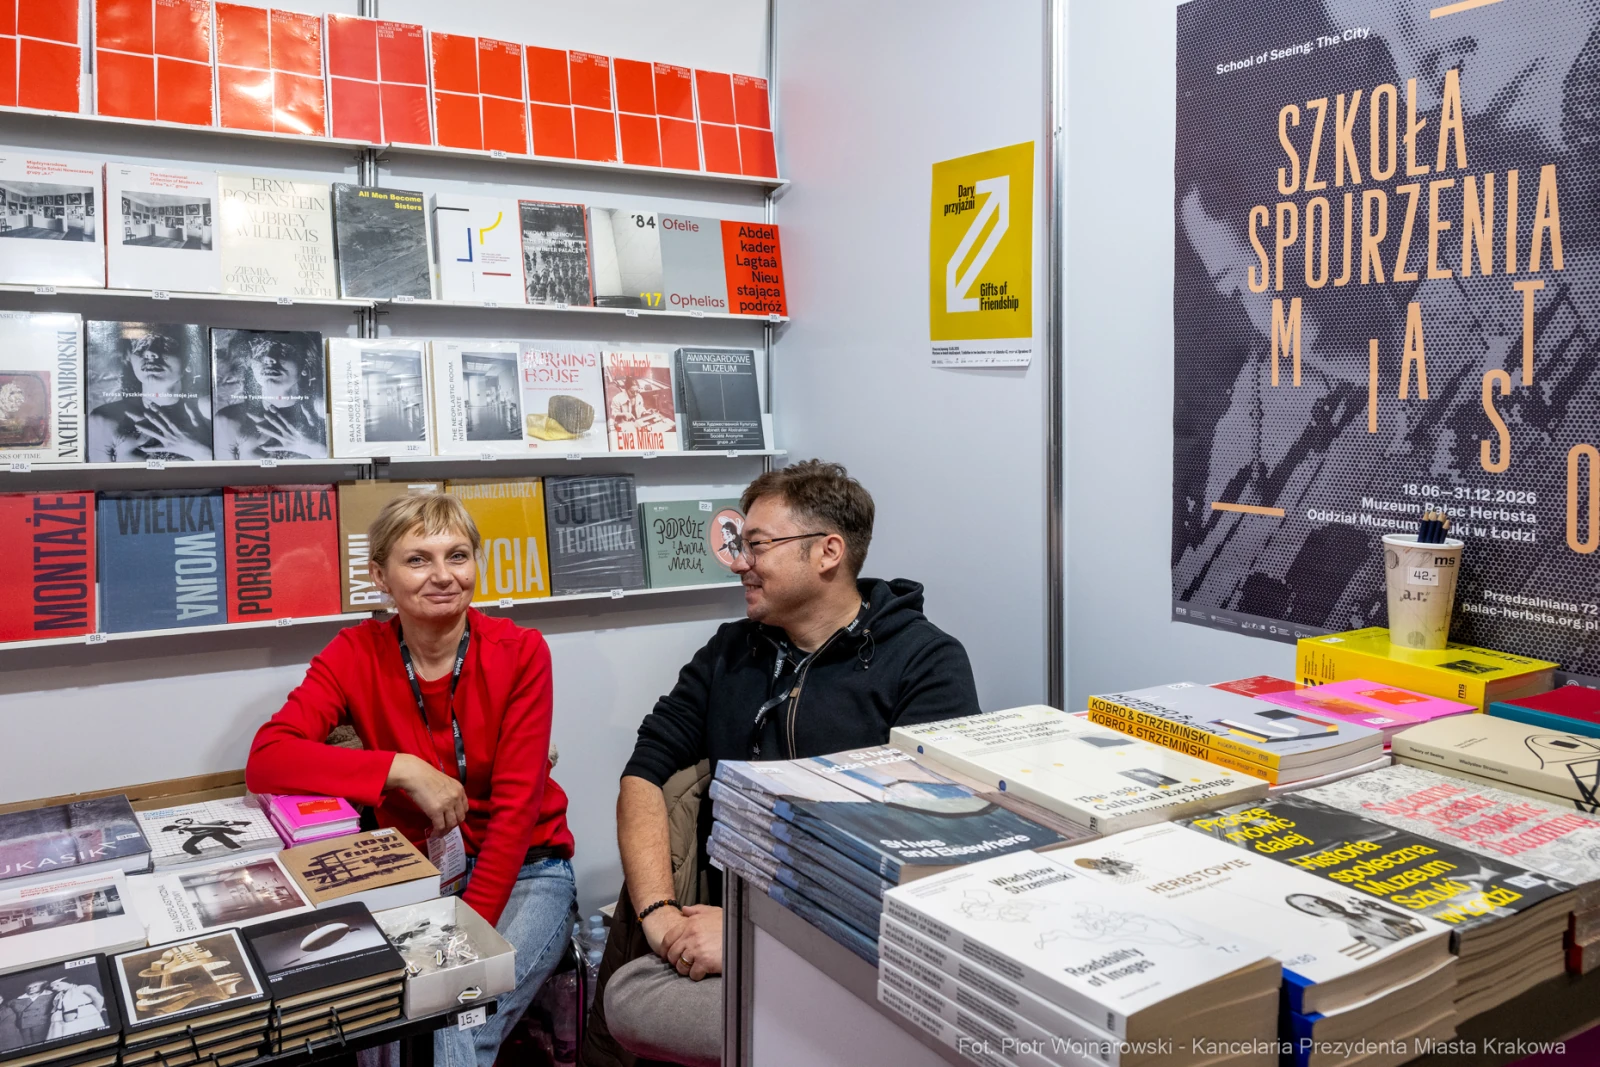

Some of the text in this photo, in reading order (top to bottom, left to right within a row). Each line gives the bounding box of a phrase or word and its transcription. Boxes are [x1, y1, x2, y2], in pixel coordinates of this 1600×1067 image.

[1216, 26, 1370, 75] School of Seeing: The City
[1277, 69, 1468, 195] SZKOŁA
[252, 178, 296, 194] ERNA
[358, 190, 422, 202] All Men Become
[958, 184, 974, 198] Dary
[394, 202, 422, 210] Sisters
[944, 196, 975, 216] przyjaźni
[237, 224, 318, 242] WILLIAMS
[662, 218, 700, 232] Ofelie
[738, 226, 774, 240] Abdel
[1248, 164, 1564, 293] SPOJRZENIA
[300, 246, 320, 255] THE
[741, 240, 776, 254] kader
[294, 254, 327, 264] EARTH
[298, 262, 322, 272] WILL
[226, 274, 278, 286] OTWORZY
[234, 266, 270, 276] ZIEMIA
[298, 270, 324, 280] OPEN
[752, 271, 779, 284] Nieu
[240, 284, 266, 294] USTA
[294, 286, 332, 296] MOUTH
[305, 279, 320, 288] ITS
[737, 284, 780, 300] stająca
[980, 281, 1008, 296] Gifts of
[670, 294, 725, 308] Ophelias
[740, 299, 782, 314] podróż
[980, 295, 1019, 312] Friendship
[610, 352, 632, 377] Słów
[686, 354, 750, 363] AWANGARDOWE
[702, 364, 738, 372] MUZEUM
[525, 368, 580, 383] HOUSE
[58, 331, 78, 458] NACHT-SAMBORSKI
[450, 384, 458, 422] NEOPLASTIC
[617, 427, 664, 450] Ewa Mikina
[115, 496, 215, 536] WIELKA
[270, 490, 332, 523] CIAŁA
[1361, 497, 1420, 514] Muzeum
[1470, 506, 1536, 524] Herbsta
[654, 516, 704, 544] PODRÓŻE
[1307, 509, 1536, 542] Oddział Muzeum w Łodzi
[556, 524, 636, 554] TECHNIKA
[26, 496, 88, 631] MONTAŻE
[234, 492, 273, 615] PORUSZONE
[1434, 556, 1456, 565] ms
[174, 532, 219, 621] WOJNA
[1484, 590, 1598, 616] Przędzalniana 72
[1462, 602, 1599, 631] palac-herbsta.org.pl
[1092, 698, 1210, 746] KOBRO & STRZEMIŃSKI
[1092, 712, 1126, 732] KOBRO
[1127, 725, 1134, 734] &
[1136, 727, 1209, 760] STRZEMIŃSKI
[849, 748, 900, 761] St Ives
[1074, 785, 1147, 804] The 1982
[1094, 777, 1234, 812] Cultural Exchange
[1224, 815, 1296, 843] mówić
[880, 838, 946, 849] St Ives
[898, 834, 1031, 858] and Elsewhere
[1254, 830, 1315, 854] dalej
[1289, 840, 1382, 871] Historia
[1328, 844, 1438, 883] społeczna
[988, 866, 1055, 887] Władysław
[1004, 872, 1076, 894] Strzemiński
[1146, 858, 1252, 894] HERBSTOWIE
[1354, 859, 1458, 897] Muzeum
[1390, 878, 1472, 910] Sztuki
[1433, 884, 1523, 924] w Łodzi
[1064, 948, 1145, 978] Readability
[1087, 959, 1156, 987] of Images
